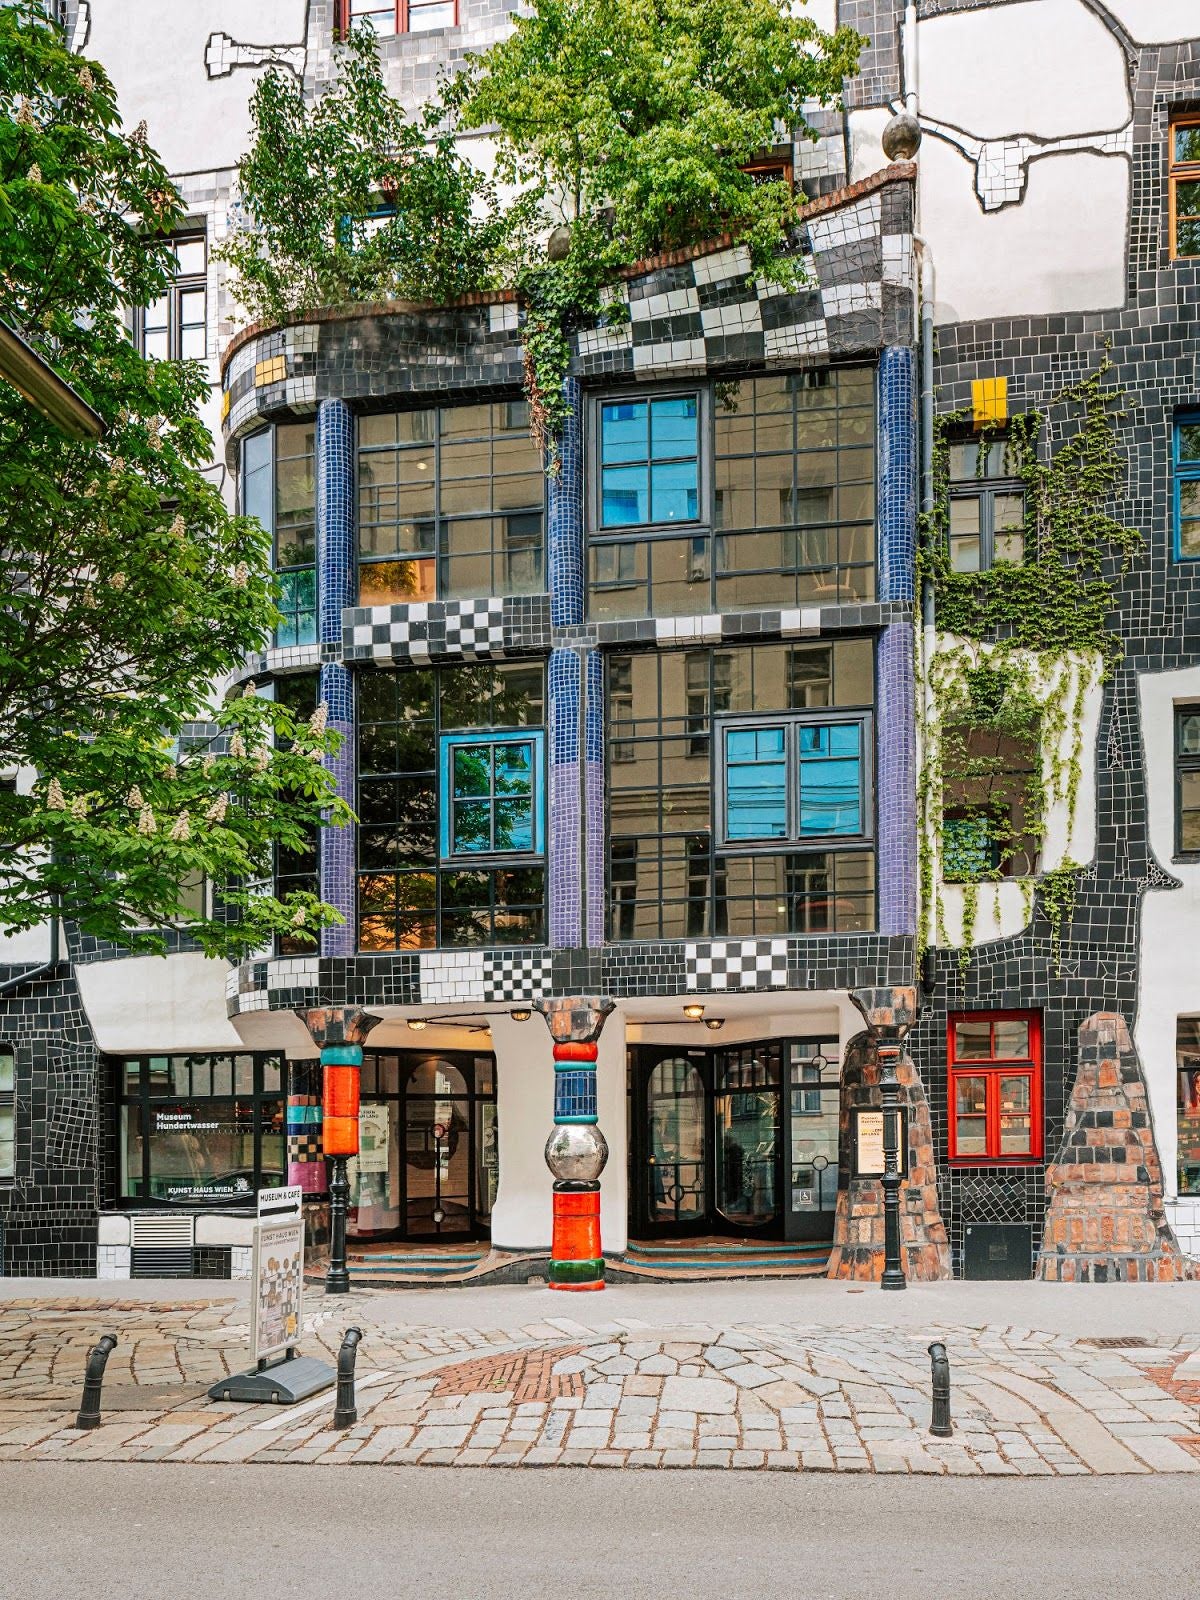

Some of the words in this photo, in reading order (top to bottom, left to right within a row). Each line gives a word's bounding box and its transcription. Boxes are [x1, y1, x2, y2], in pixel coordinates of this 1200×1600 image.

[156, 1121, 219, 1130] Hundertwasser
[193, 1186, 213, 1194] HAUS
[260, 1192, 283, 1202] MUSEUM
[283, 1191, 288, 1200] &
